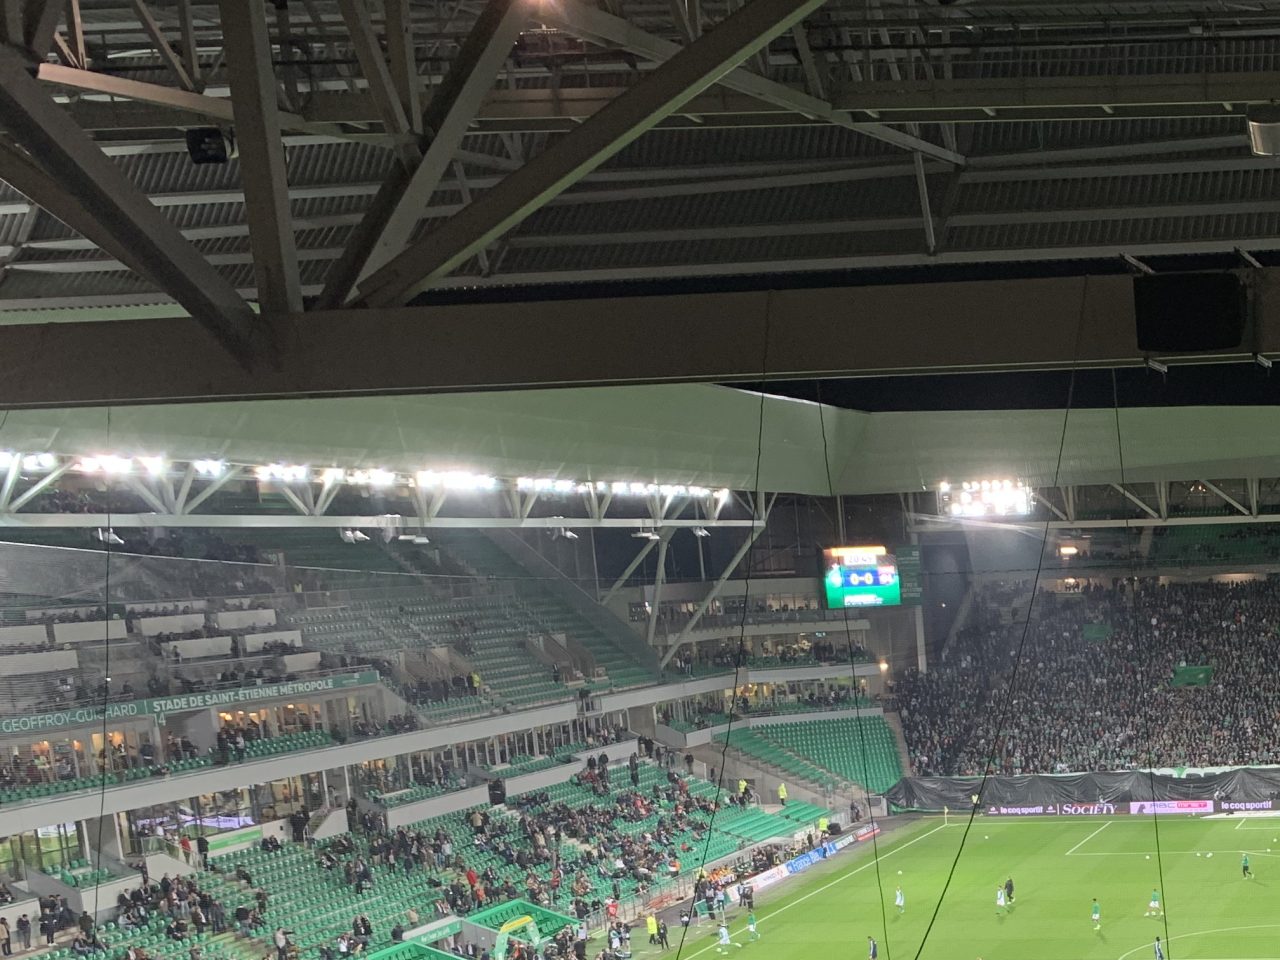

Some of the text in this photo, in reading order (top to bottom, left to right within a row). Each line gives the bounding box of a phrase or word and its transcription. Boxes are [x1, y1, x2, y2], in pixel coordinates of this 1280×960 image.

[153, 679, 334, 713] STADE DE SAINT-ÉTIENNE MÉTROPOLE
[1221, 801, 1229, 809] le
[1245, 800, 1272, 810] sportif
